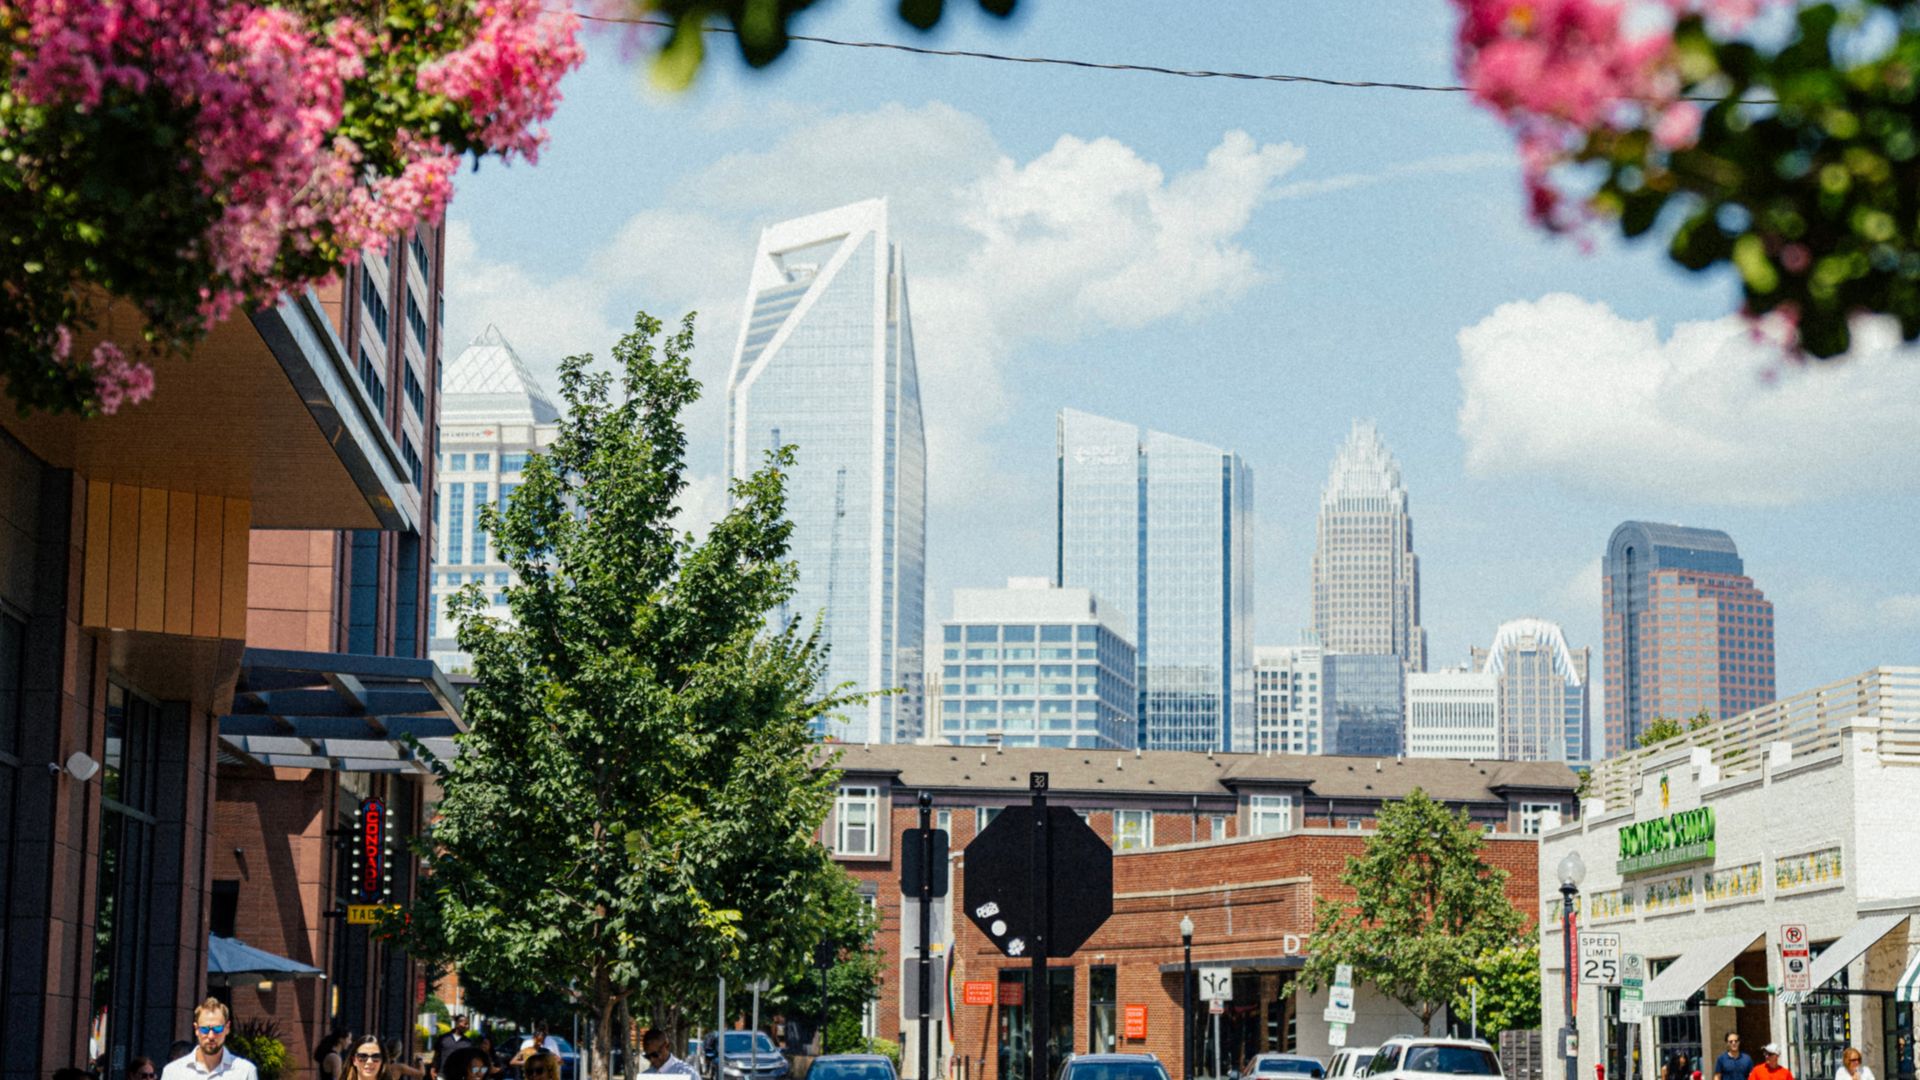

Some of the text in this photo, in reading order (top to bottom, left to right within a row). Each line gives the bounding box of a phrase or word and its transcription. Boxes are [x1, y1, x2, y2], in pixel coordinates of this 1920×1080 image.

[1582, 938, 1617, 947] SPEED
[1585, 949, 1613, 957] LIMIT
[1584, 959, 1617, 978] 25
